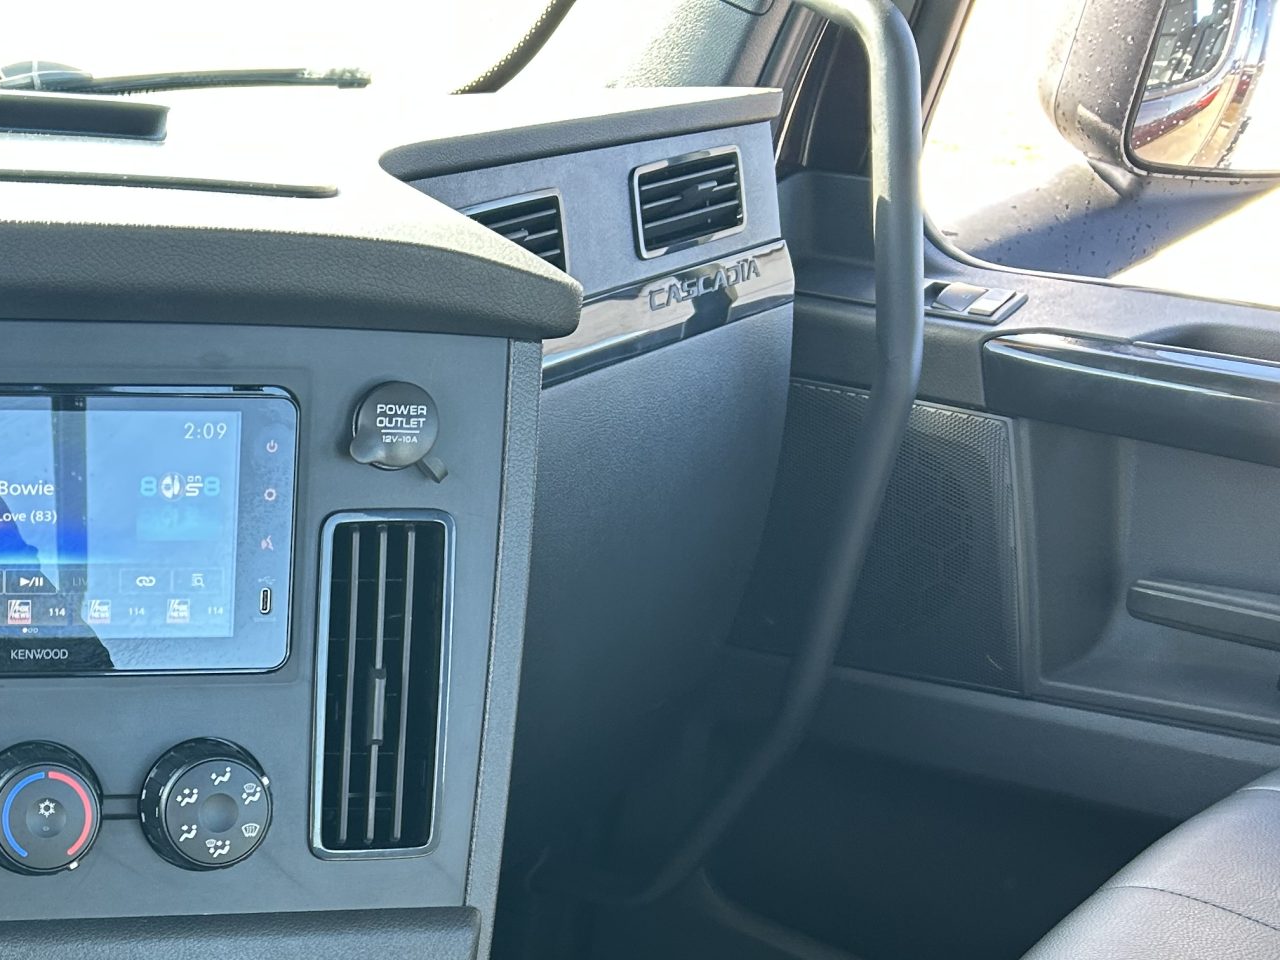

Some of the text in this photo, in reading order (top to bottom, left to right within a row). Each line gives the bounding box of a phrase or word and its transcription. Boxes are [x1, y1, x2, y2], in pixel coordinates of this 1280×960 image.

[649, 258, 760, 311] CASCADIA
[376, 404, 427, 415] POWER
[376, 417, 426, 428] OUTLET
[184, 423, 227, 439] 2:09
[382, 435, 418, 443] 12V-10A
[30, 510, 57, 524] (83)
[49, 608, 65, 617] 114
[128, 607, 145, 616] 114
[207, 606, 223, 616] 114
[10, 649, 68, 660] KENWOOD
